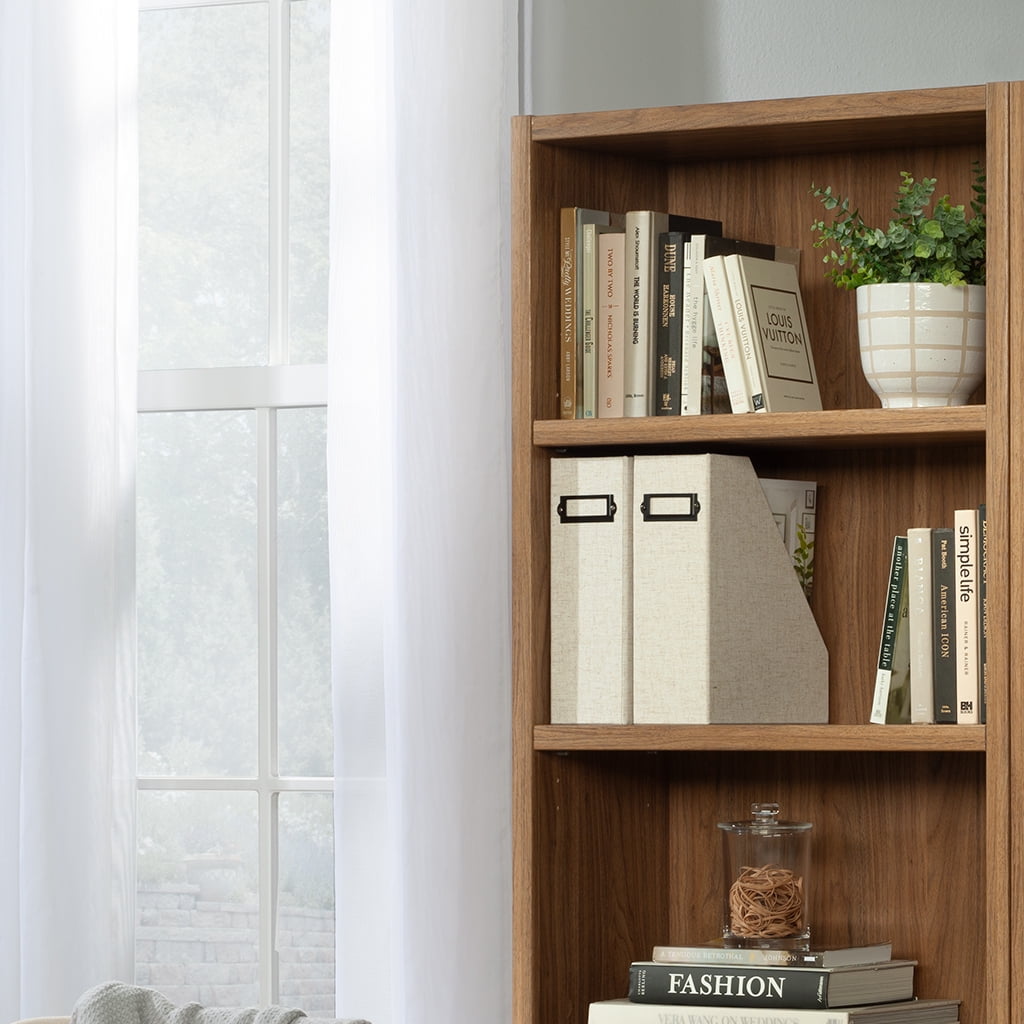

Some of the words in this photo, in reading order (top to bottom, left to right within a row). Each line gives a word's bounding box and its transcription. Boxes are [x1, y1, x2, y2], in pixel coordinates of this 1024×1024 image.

[664, 244, 676, 272] DUNE
[607, 268, 613, 278] BY
[564, 287, 572, 343] WEDDINGS
[766, 312, 792, 328] LOUIS
[735, 299, 744, 323] LOUIS
[740, 324, 752, 360] VUITTON
[762, 327, 803, 345] VUITTON
[891, 546, 904, 581] another
[888, 584, 899, 609] place
[940, 584, 949, 630] American
[888, 612, 895, 622] at
[885, 625, 894, 640] the
[881, 643, 892, 667] table
[941, 633, 949, 658] ICON
[668, 973, 785, 998] FASHION
